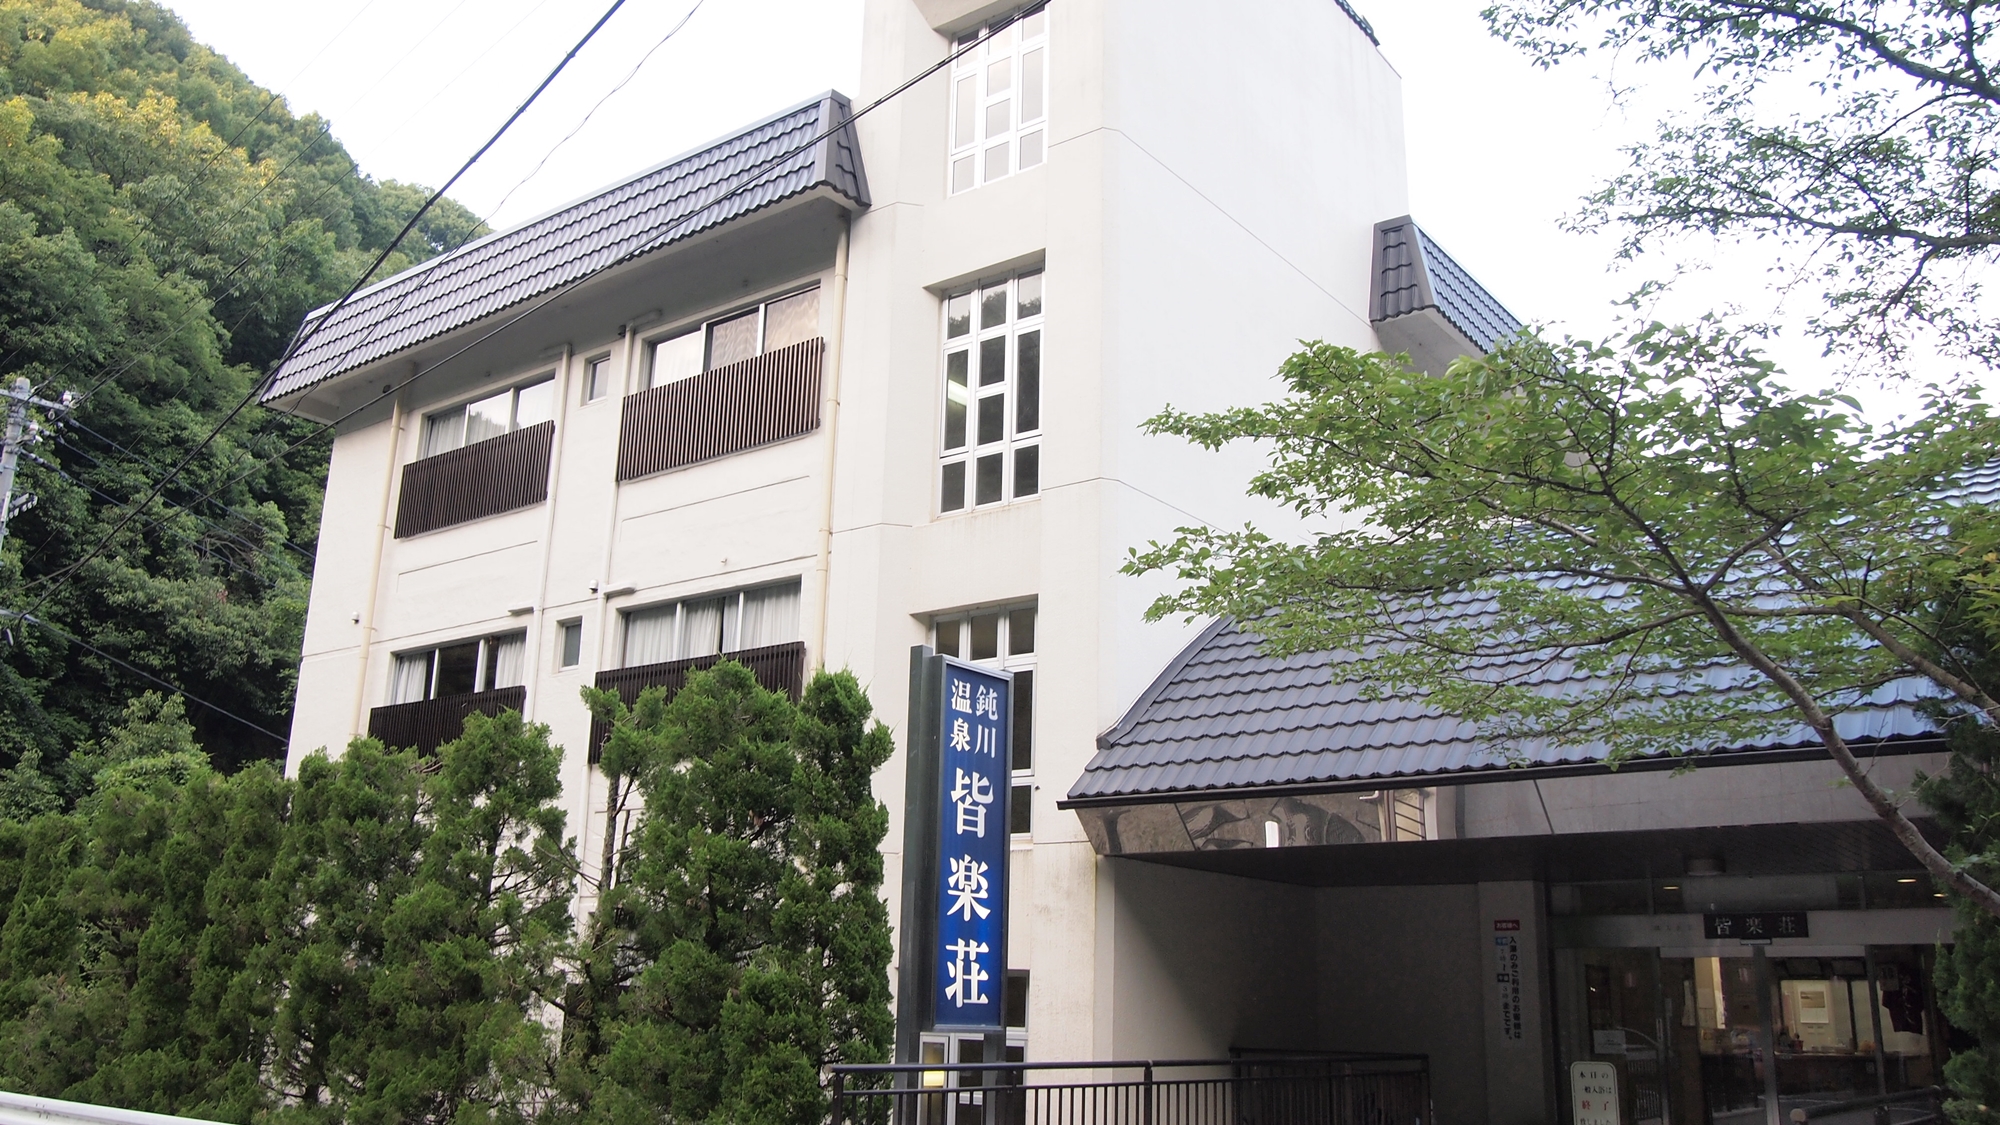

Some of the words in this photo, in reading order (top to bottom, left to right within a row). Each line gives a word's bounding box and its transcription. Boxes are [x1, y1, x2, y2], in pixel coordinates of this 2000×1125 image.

[950, 678, 972, 752] 温泉
[975, 684, 998, 758] 鈍川
[945, 767, 994, 1008] 皆楽荘
[1714, 916, 1796, 935] 皆楽荘
[1579, 1071, 1609, 1079] 本日の
